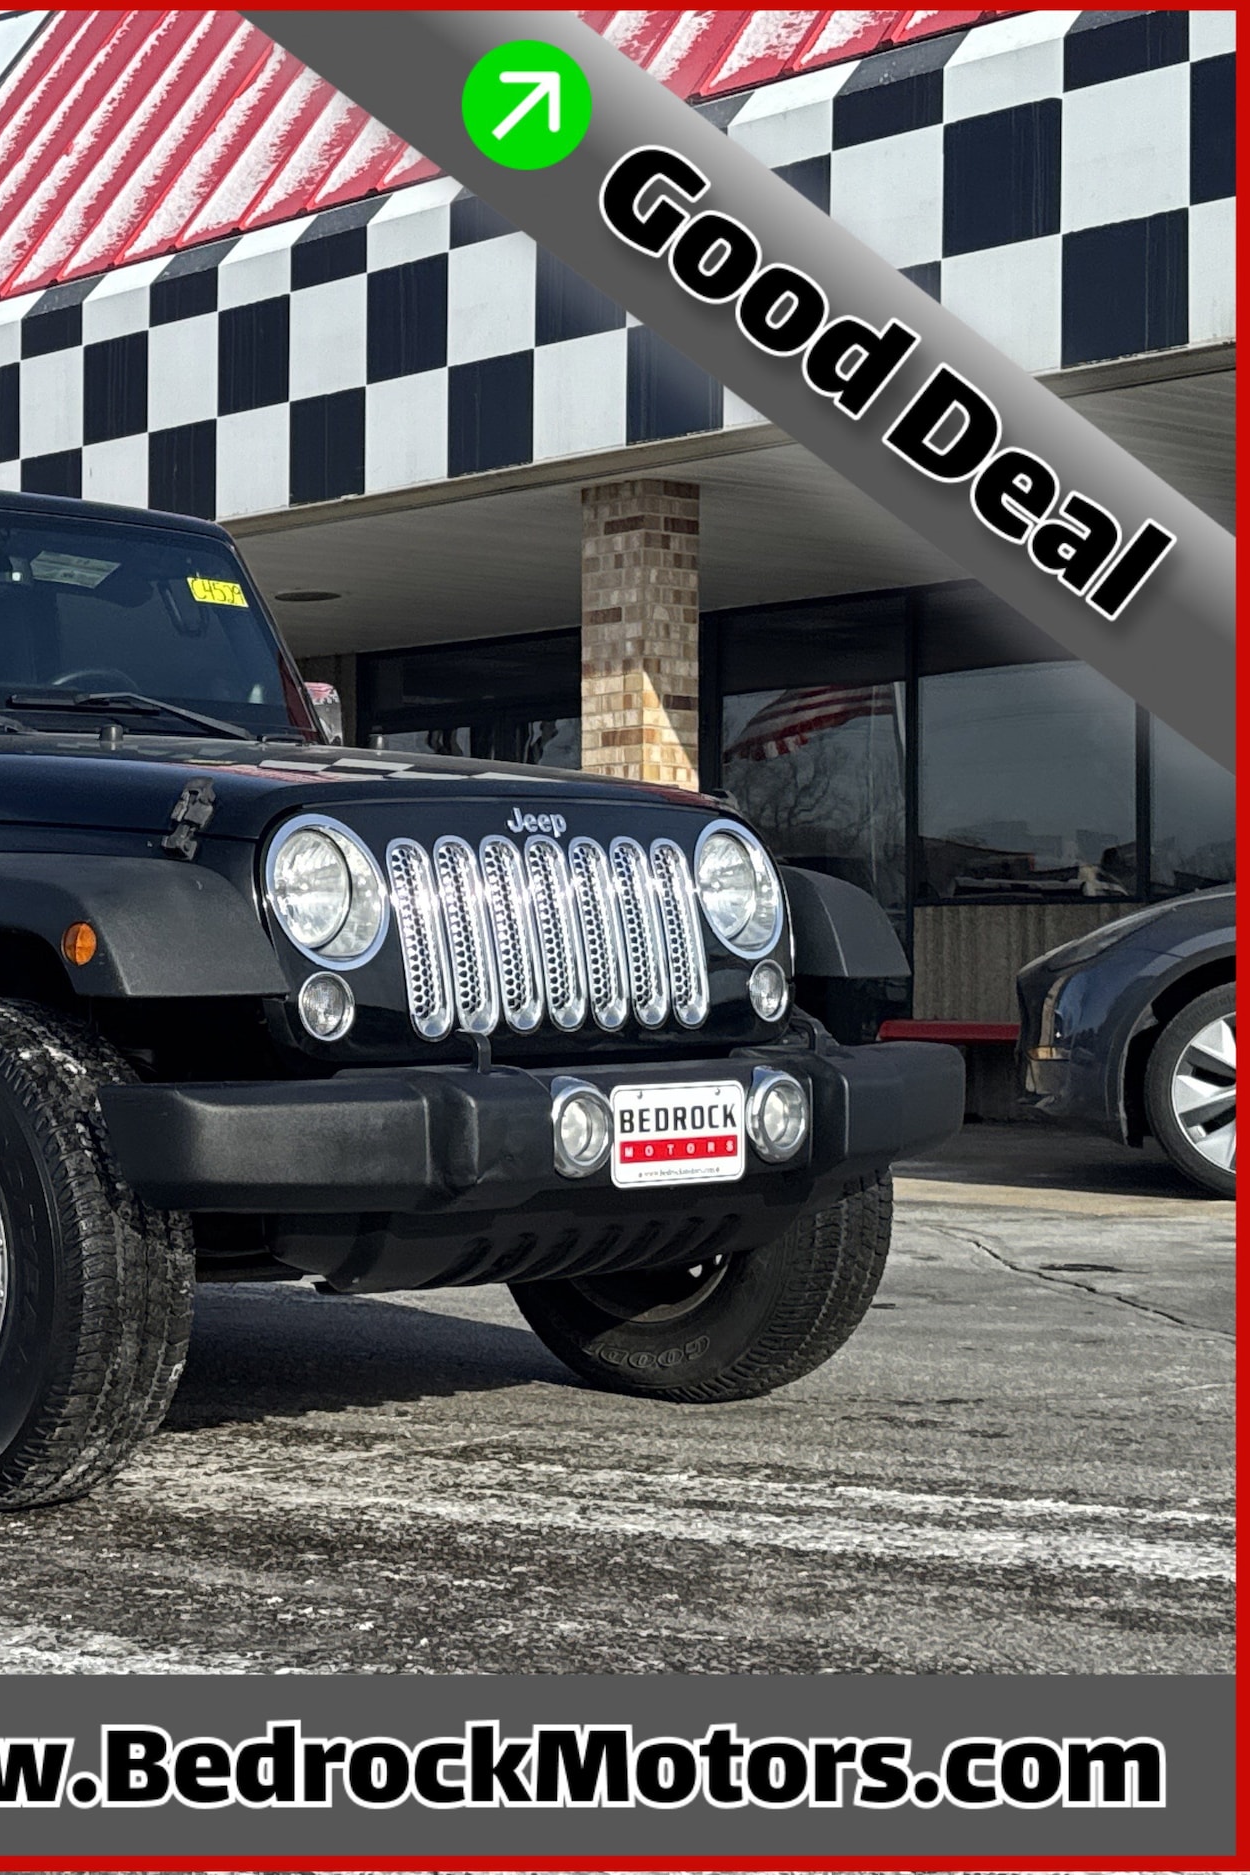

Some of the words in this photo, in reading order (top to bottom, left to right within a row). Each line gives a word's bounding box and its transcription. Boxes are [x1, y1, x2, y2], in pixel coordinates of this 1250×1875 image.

[507, 807, 567, 838] Jeep
[619, 1103, 737, 1134] BEDROCK
[624, 1139, 735, 1158] MOTORS
